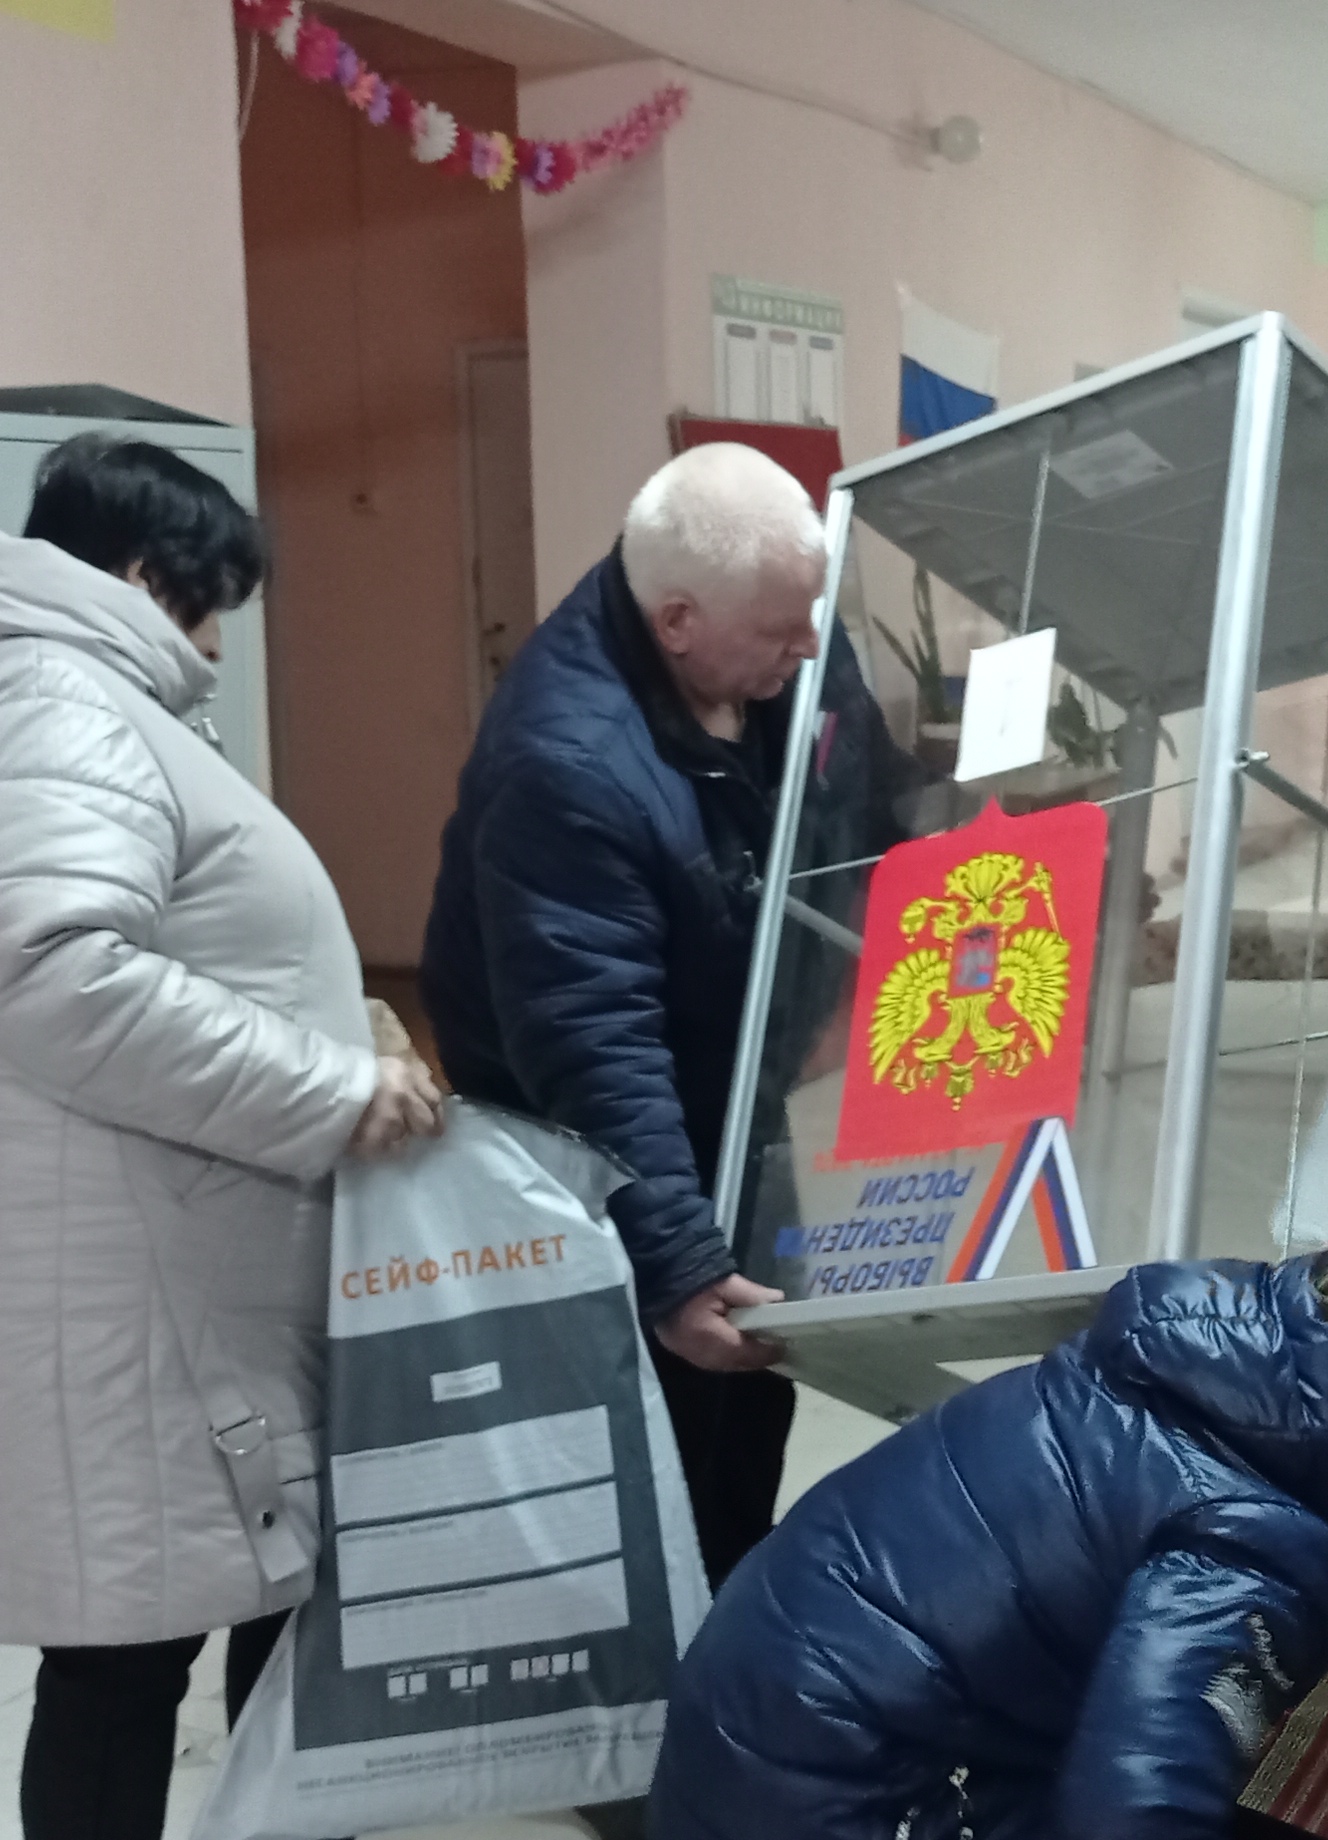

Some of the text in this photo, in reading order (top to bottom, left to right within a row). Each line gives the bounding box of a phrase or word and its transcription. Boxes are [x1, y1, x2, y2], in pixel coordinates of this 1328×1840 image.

[856, 1166, 976, 1209] РОССИИ
[775, 1212, 955, 1258] ПРЕЗИДЕН
[340, 1233, 567, 1300] СЕЙФ-ПАКЕТ
[807, 1255, 935, 1295] ВЫБОРЫ
